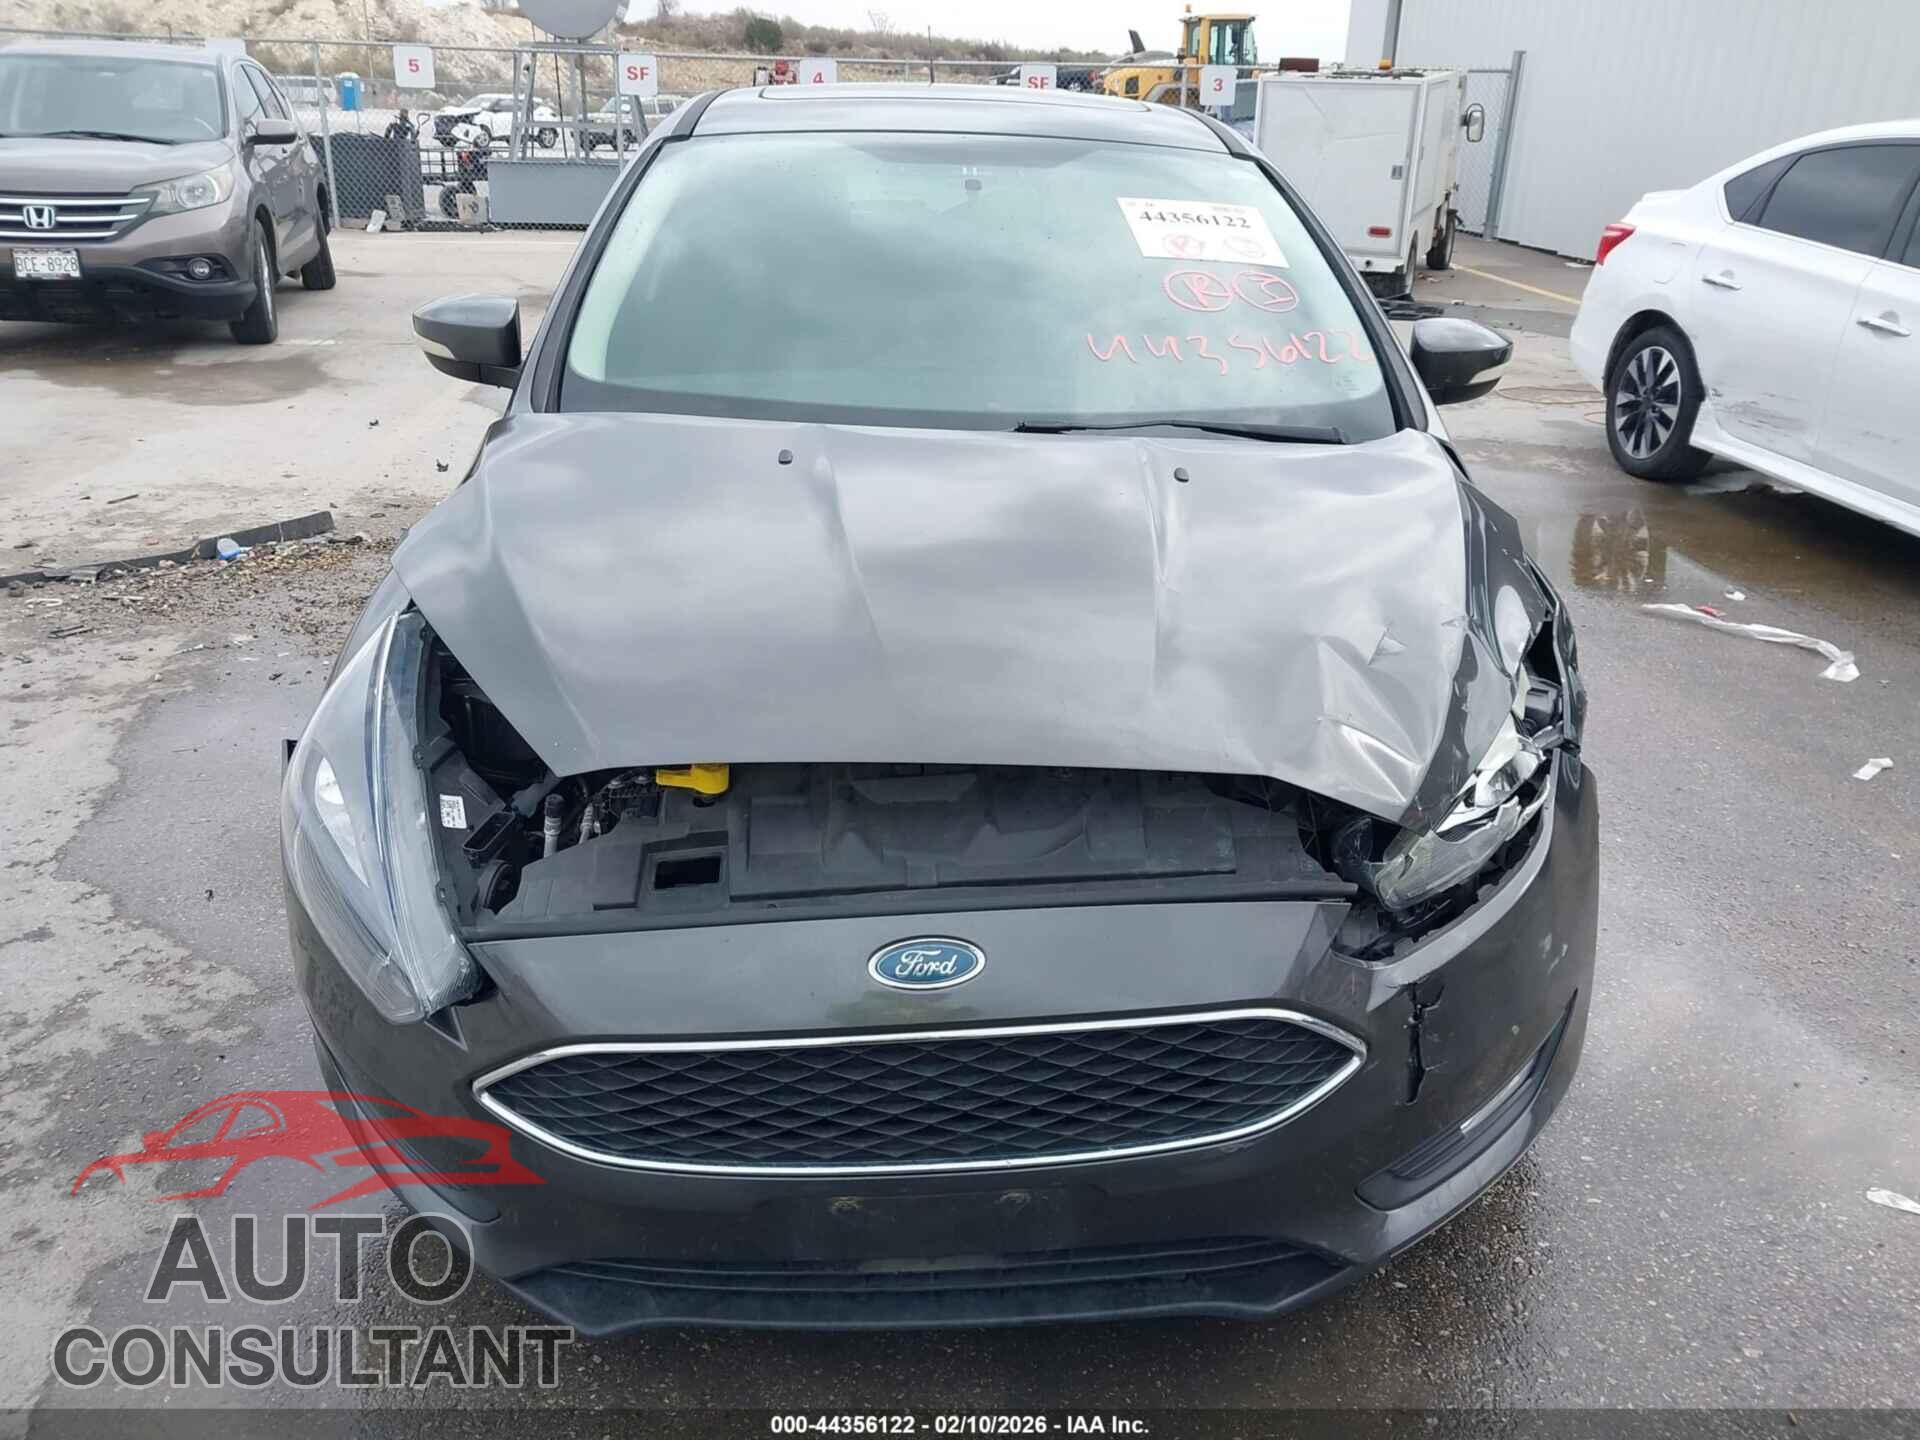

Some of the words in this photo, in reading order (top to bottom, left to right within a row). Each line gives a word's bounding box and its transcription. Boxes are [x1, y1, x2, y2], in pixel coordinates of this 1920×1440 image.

[409, 59, 420, 73] 5
[626, 65, 649, 81] SF
[812, 71, 825, 84] 4
[1028, 76, 1049, 89] SF
[1214, 78, 1223, 91] 3
[1140, 210, 1252, 229] 44356122
[895, 949, 958, 977] Ford
